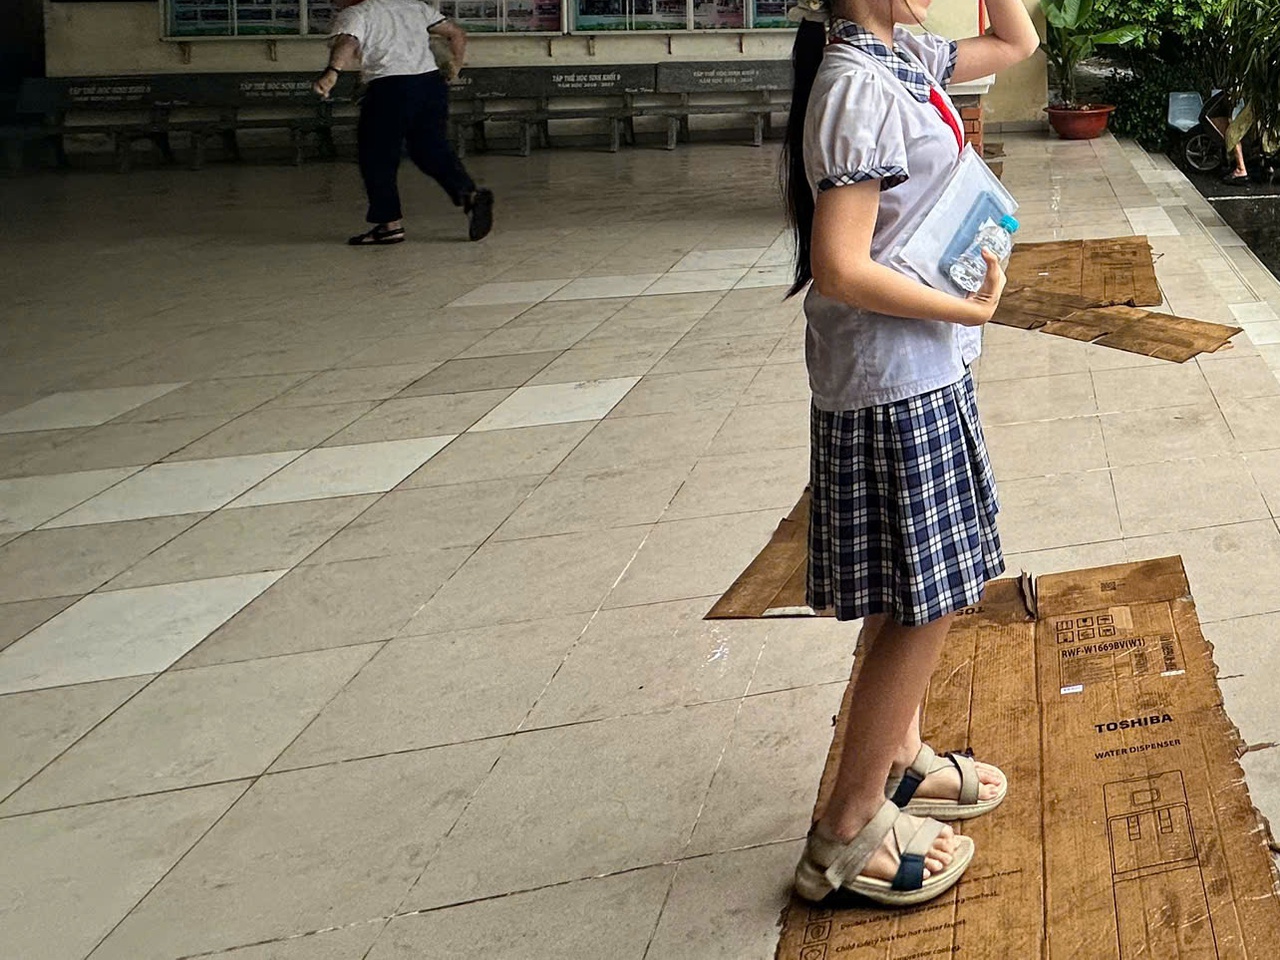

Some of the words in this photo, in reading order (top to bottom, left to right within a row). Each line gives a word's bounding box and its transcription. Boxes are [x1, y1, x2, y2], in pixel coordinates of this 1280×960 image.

[1094, 713, 1173, 733] TOSHIBA
[1094, 747, 1128, 760] WATER
[1129, 738, 1181, 753] DISPENSER
